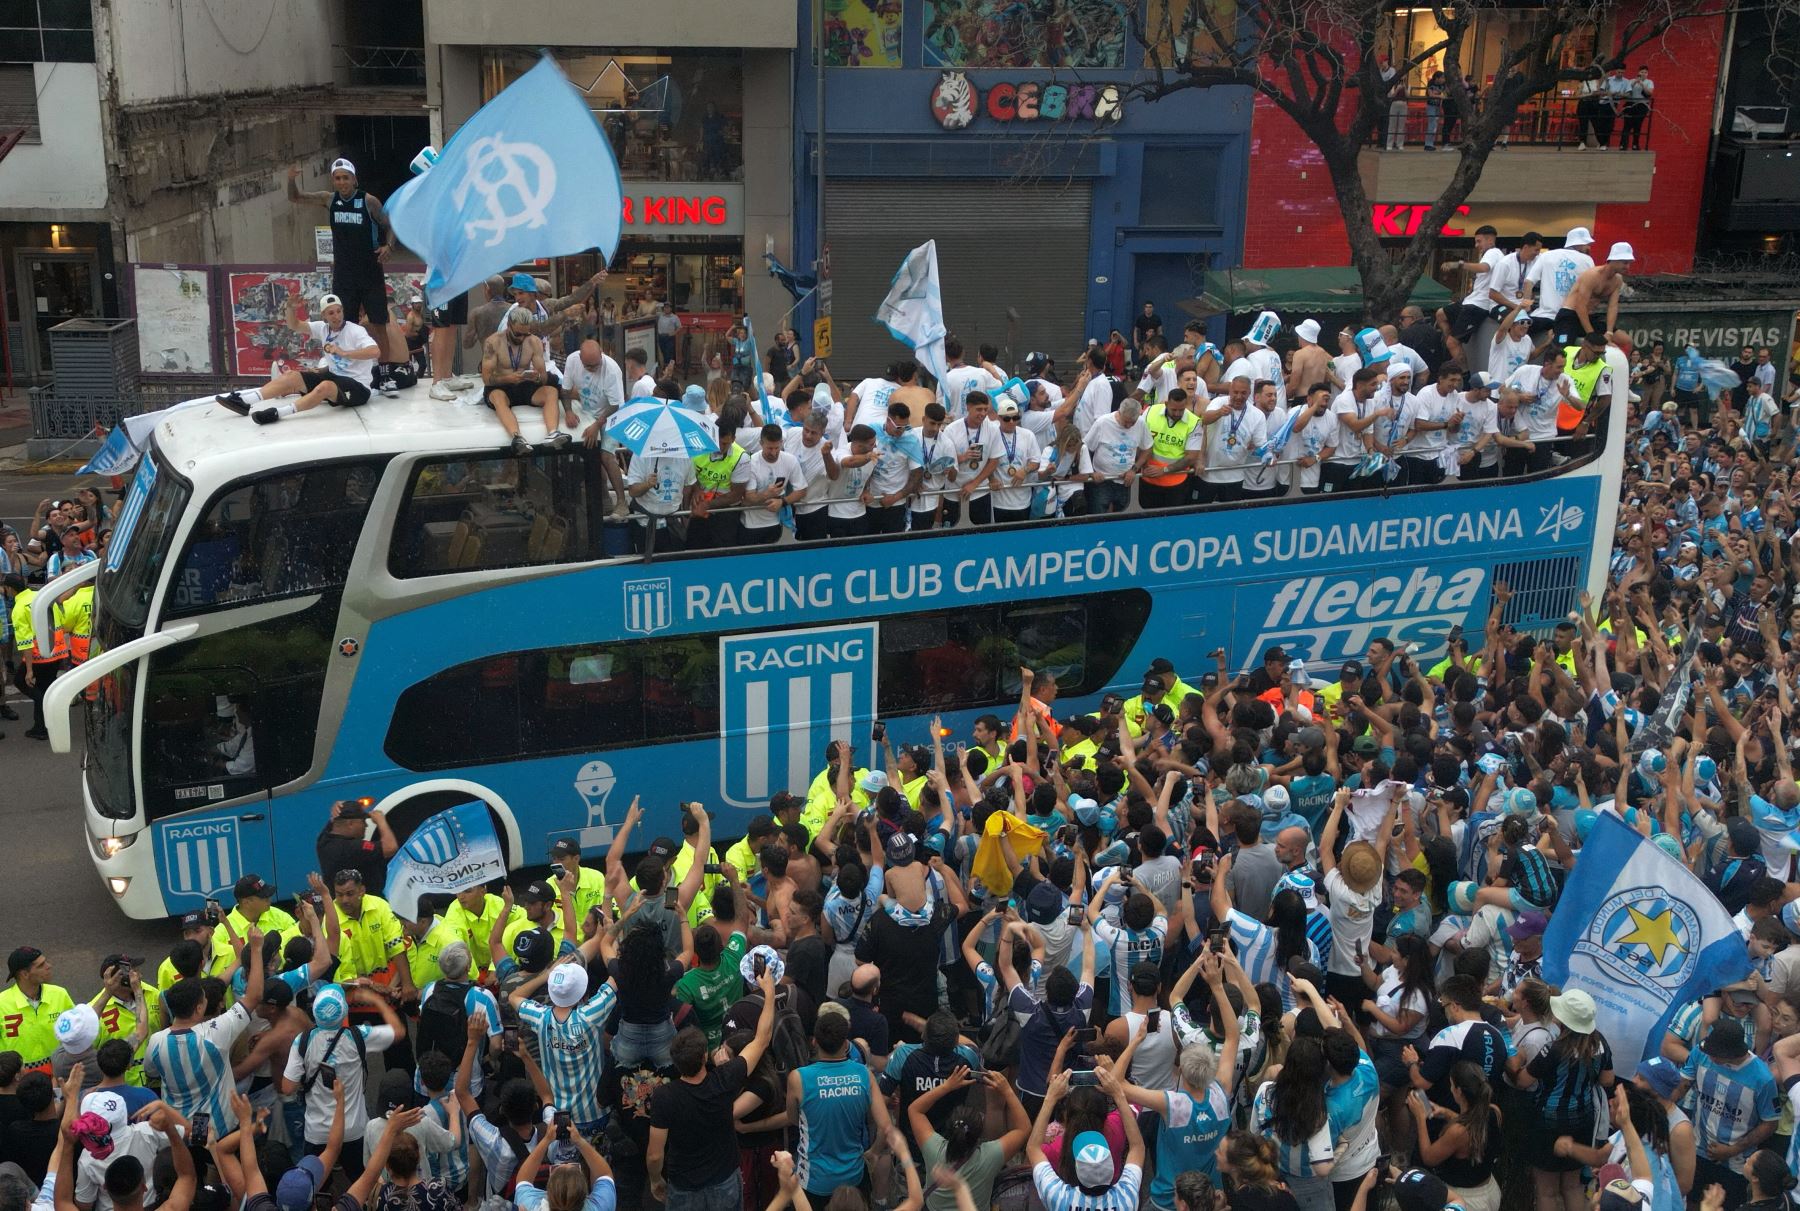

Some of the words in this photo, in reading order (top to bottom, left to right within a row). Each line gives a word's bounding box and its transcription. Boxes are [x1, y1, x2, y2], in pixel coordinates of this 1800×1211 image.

[643, 196, 726, 225] KING
[1674, 327, 1780, 349] REVISTAS
[686, 573, 833, 620] RACING
[845, 563, 943, 604] CLUB
[954, 541, 1138, 593] CAMPEÓN
[1150, 534, 1243, 574] COPA
[1252, 508, 1524, 565] SUDAMERICANA
[628, 582, 667, 593] RACING
[1262, 566, 1486, 628] flecha
[1247, 617, 1456, 668] BUS
[734, 638, 865, 673] RACING
[1298, 794, 1330, 808] RACING
[170, 823, 232, 839] RACING
[838, 899, 873, 915] Maco
[817, 1075, 861, 1087] Kappa
[819, 1085, 859, 1099] RACING
[1183, 1130, 1218, 1144] RACING
